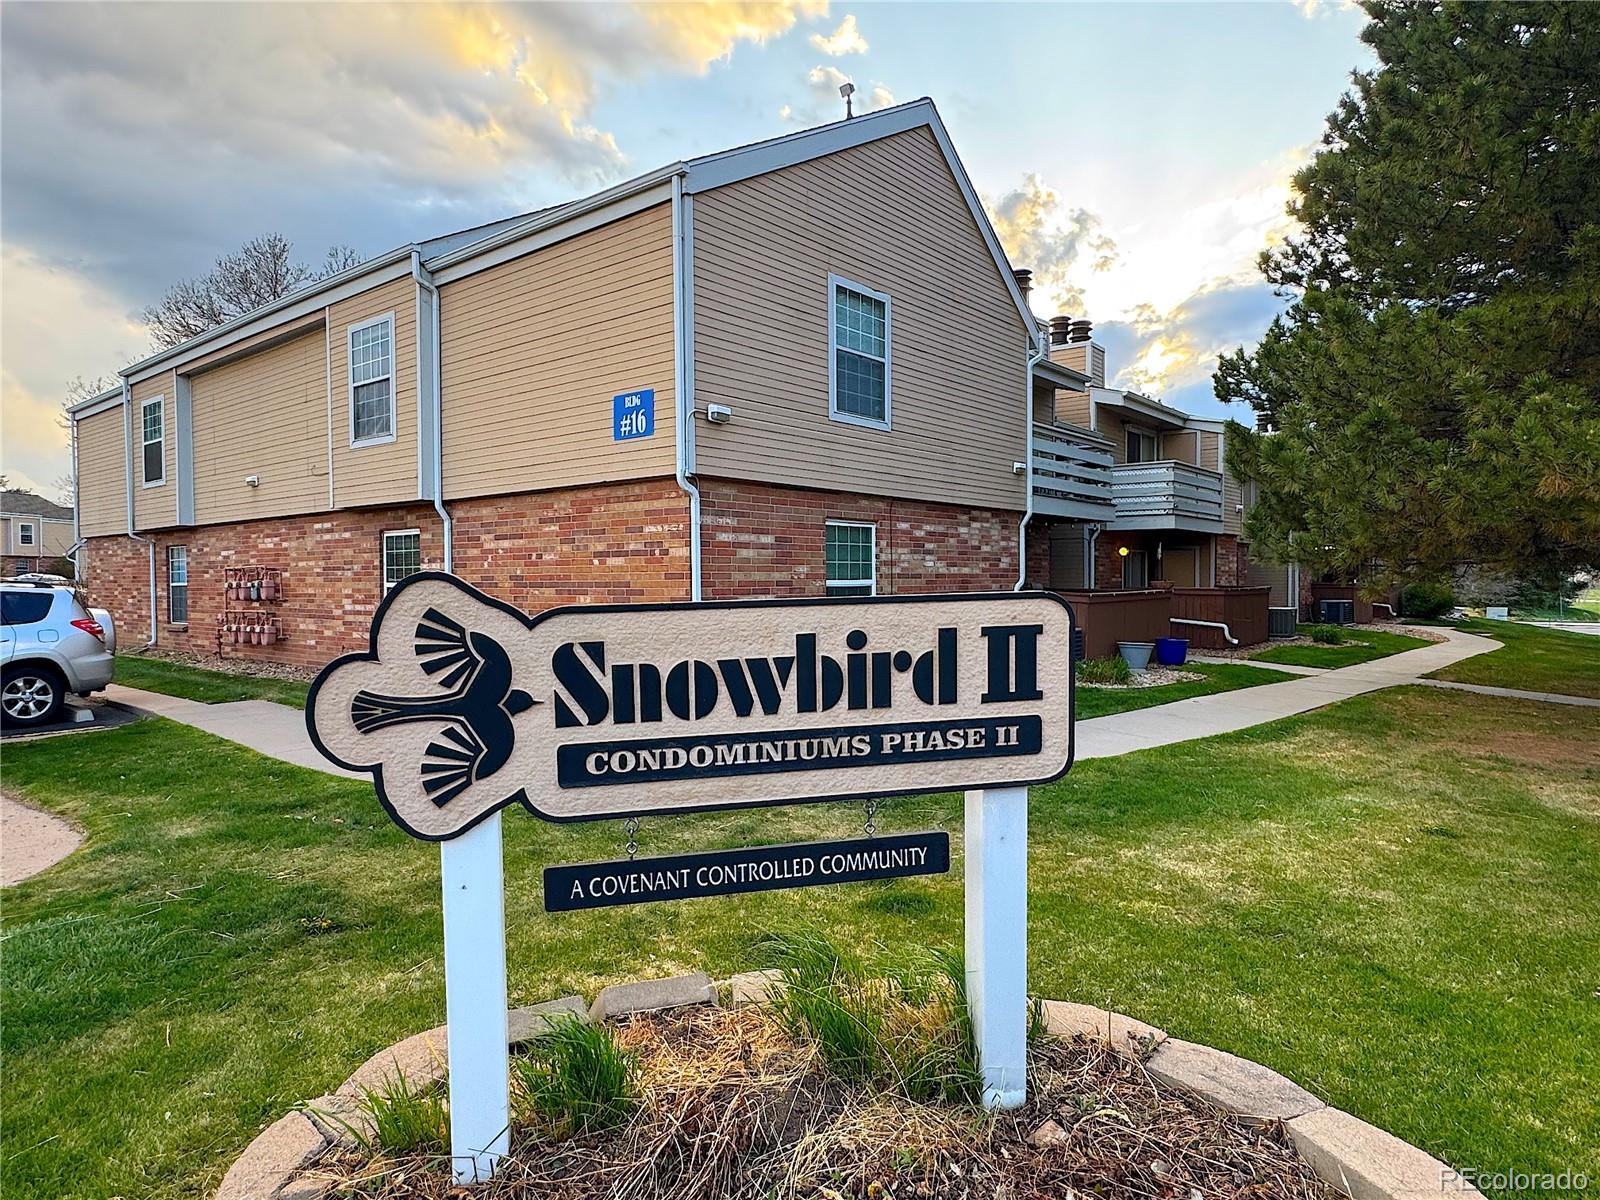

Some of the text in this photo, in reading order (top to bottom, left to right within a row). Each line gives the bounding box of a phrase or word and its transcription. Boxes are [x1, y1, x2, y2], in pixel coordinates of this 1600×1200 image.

[620, 409, 646, 436] #16
[625, 395, 640, 408] BLDG
[551, 624, 1044, 729] Snowbird II
[585, 725, 1020, 775] CONDOMINIUMS PHASE II
[570, 846, 929, 900] A COVENANT CONTROLLED COMMUNITY
